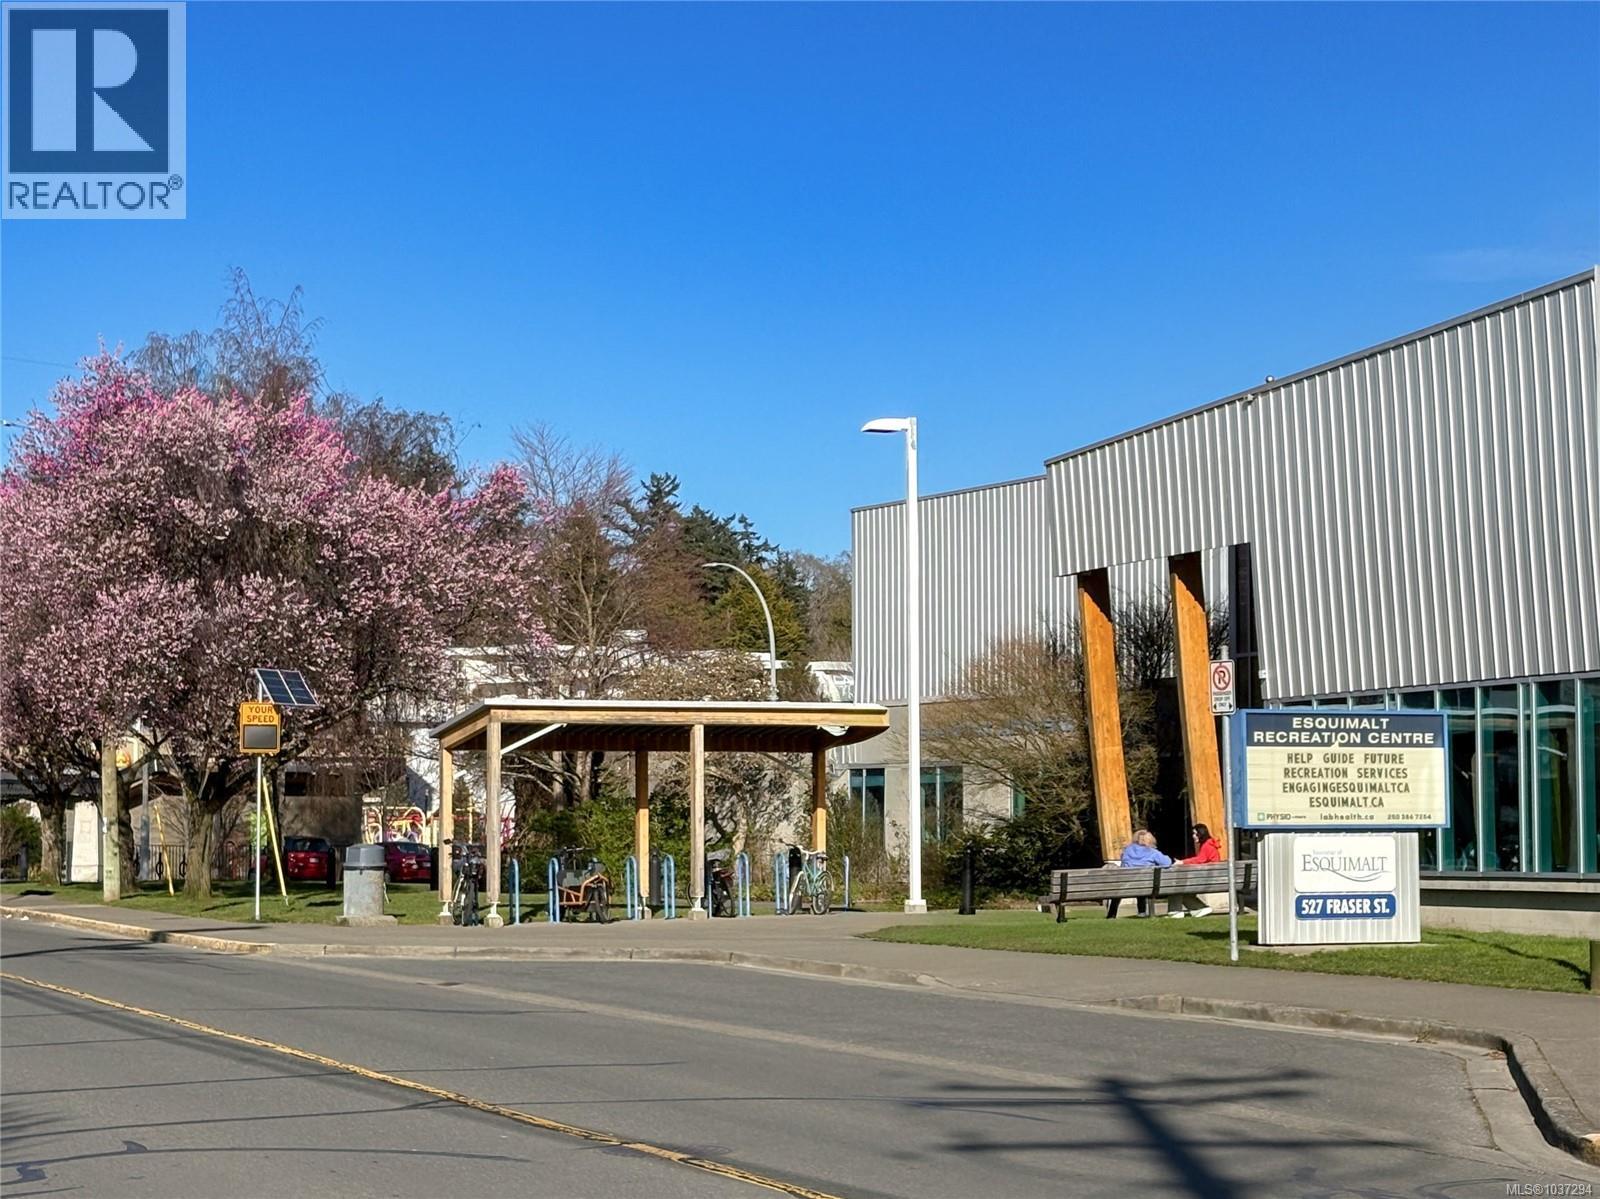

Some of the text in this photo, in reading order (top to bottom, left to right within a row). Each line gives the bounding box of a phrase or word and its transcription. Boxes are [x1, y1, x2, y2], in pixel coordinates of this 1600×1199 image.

[249, 706, 273, 714] YOUR
[247, 715, 275, 723] SPEED
[1292, 717, 1390, 730] ESQUIMALT
[1253, 731, 1435, 744] RECREATION CENTRE
[1287, 752, 1405, 764] HELP GUIDE FUTURE
[1283, 767, 1408, 779] RECREATION SERVICES
[1309, 796, 1385, 808] ESQUIMALT.CA
[1266, 813, 1291, 821] PHYSIO
[1301, 854, 1388, 872] ESQUIMALT
[1301, 898, 1390, 915] 527 FRASER ST.
